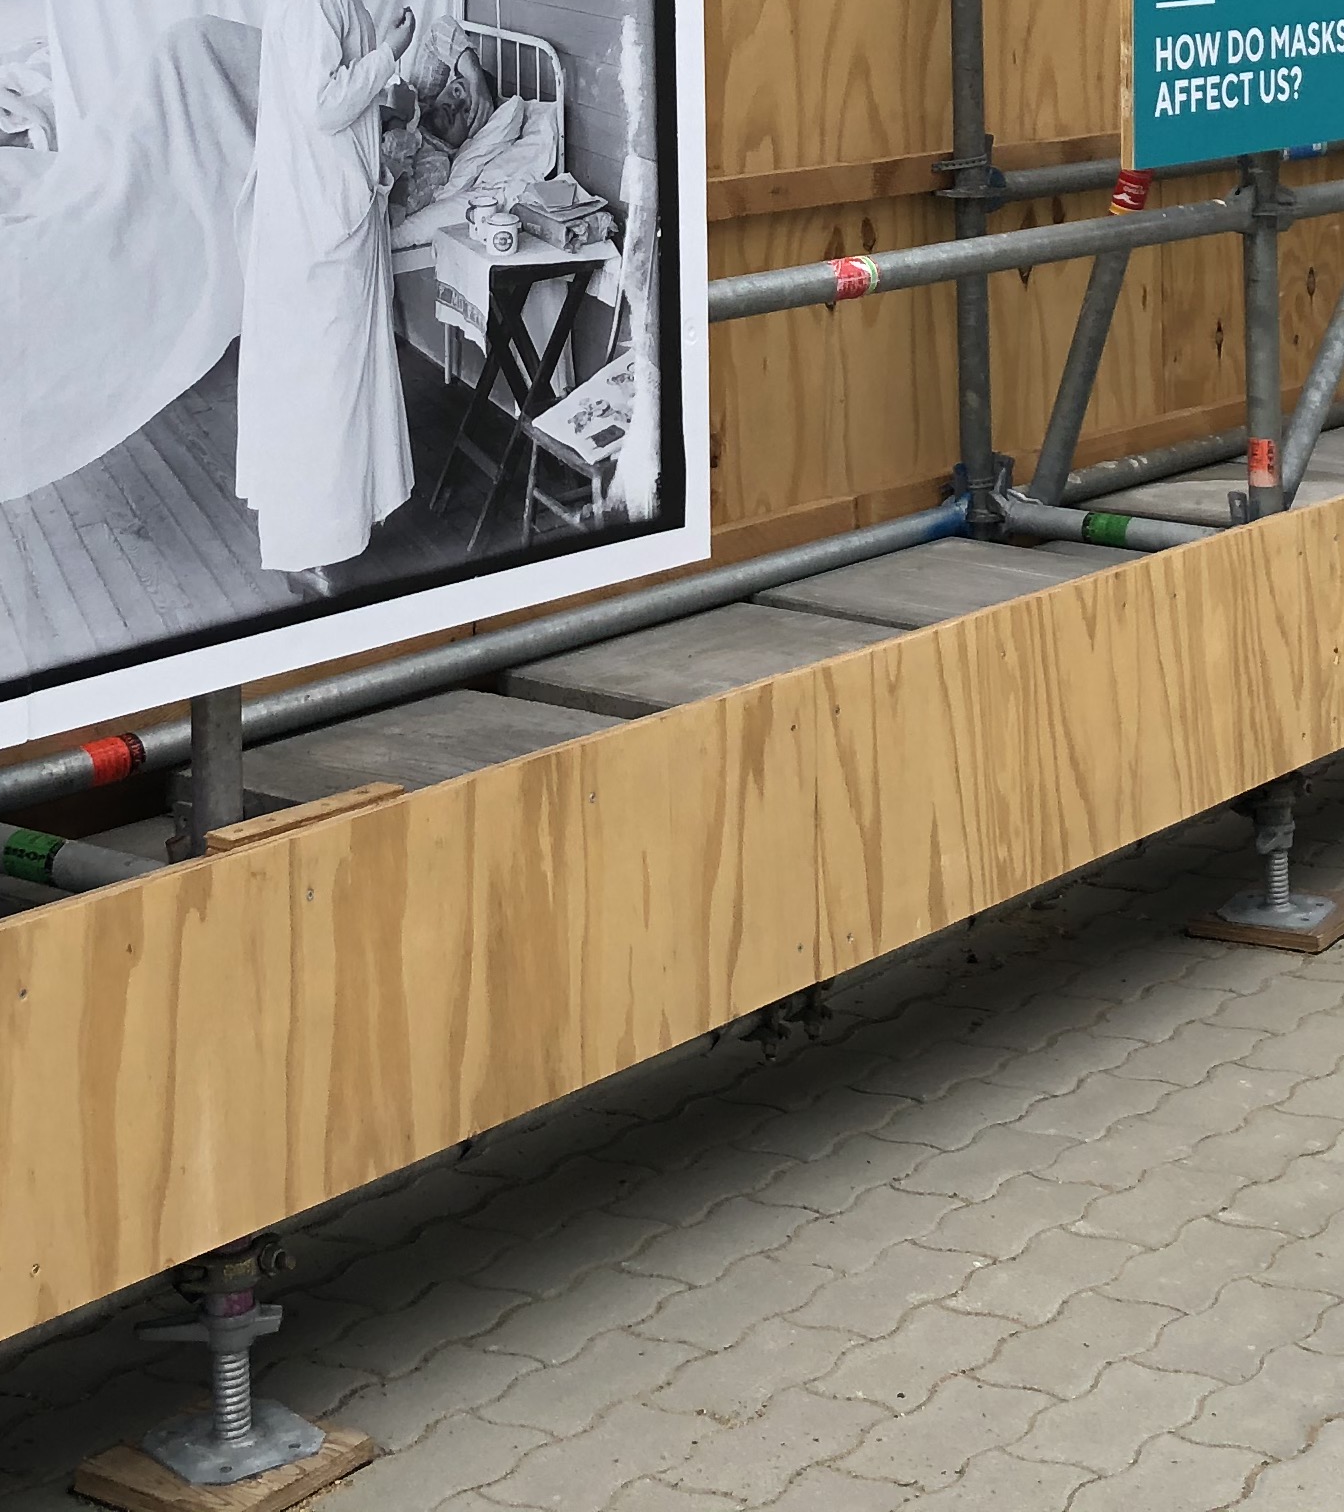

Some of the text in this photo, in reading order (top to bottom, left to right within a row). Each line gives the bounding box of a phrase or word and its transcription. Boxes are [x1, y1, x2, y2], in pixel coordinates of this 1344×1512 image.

[1155, 31, 1222, 73] HOW
[1228, 26, 1264, 63] DO
[1154, 65, 1303, 118] AFFECT US?
